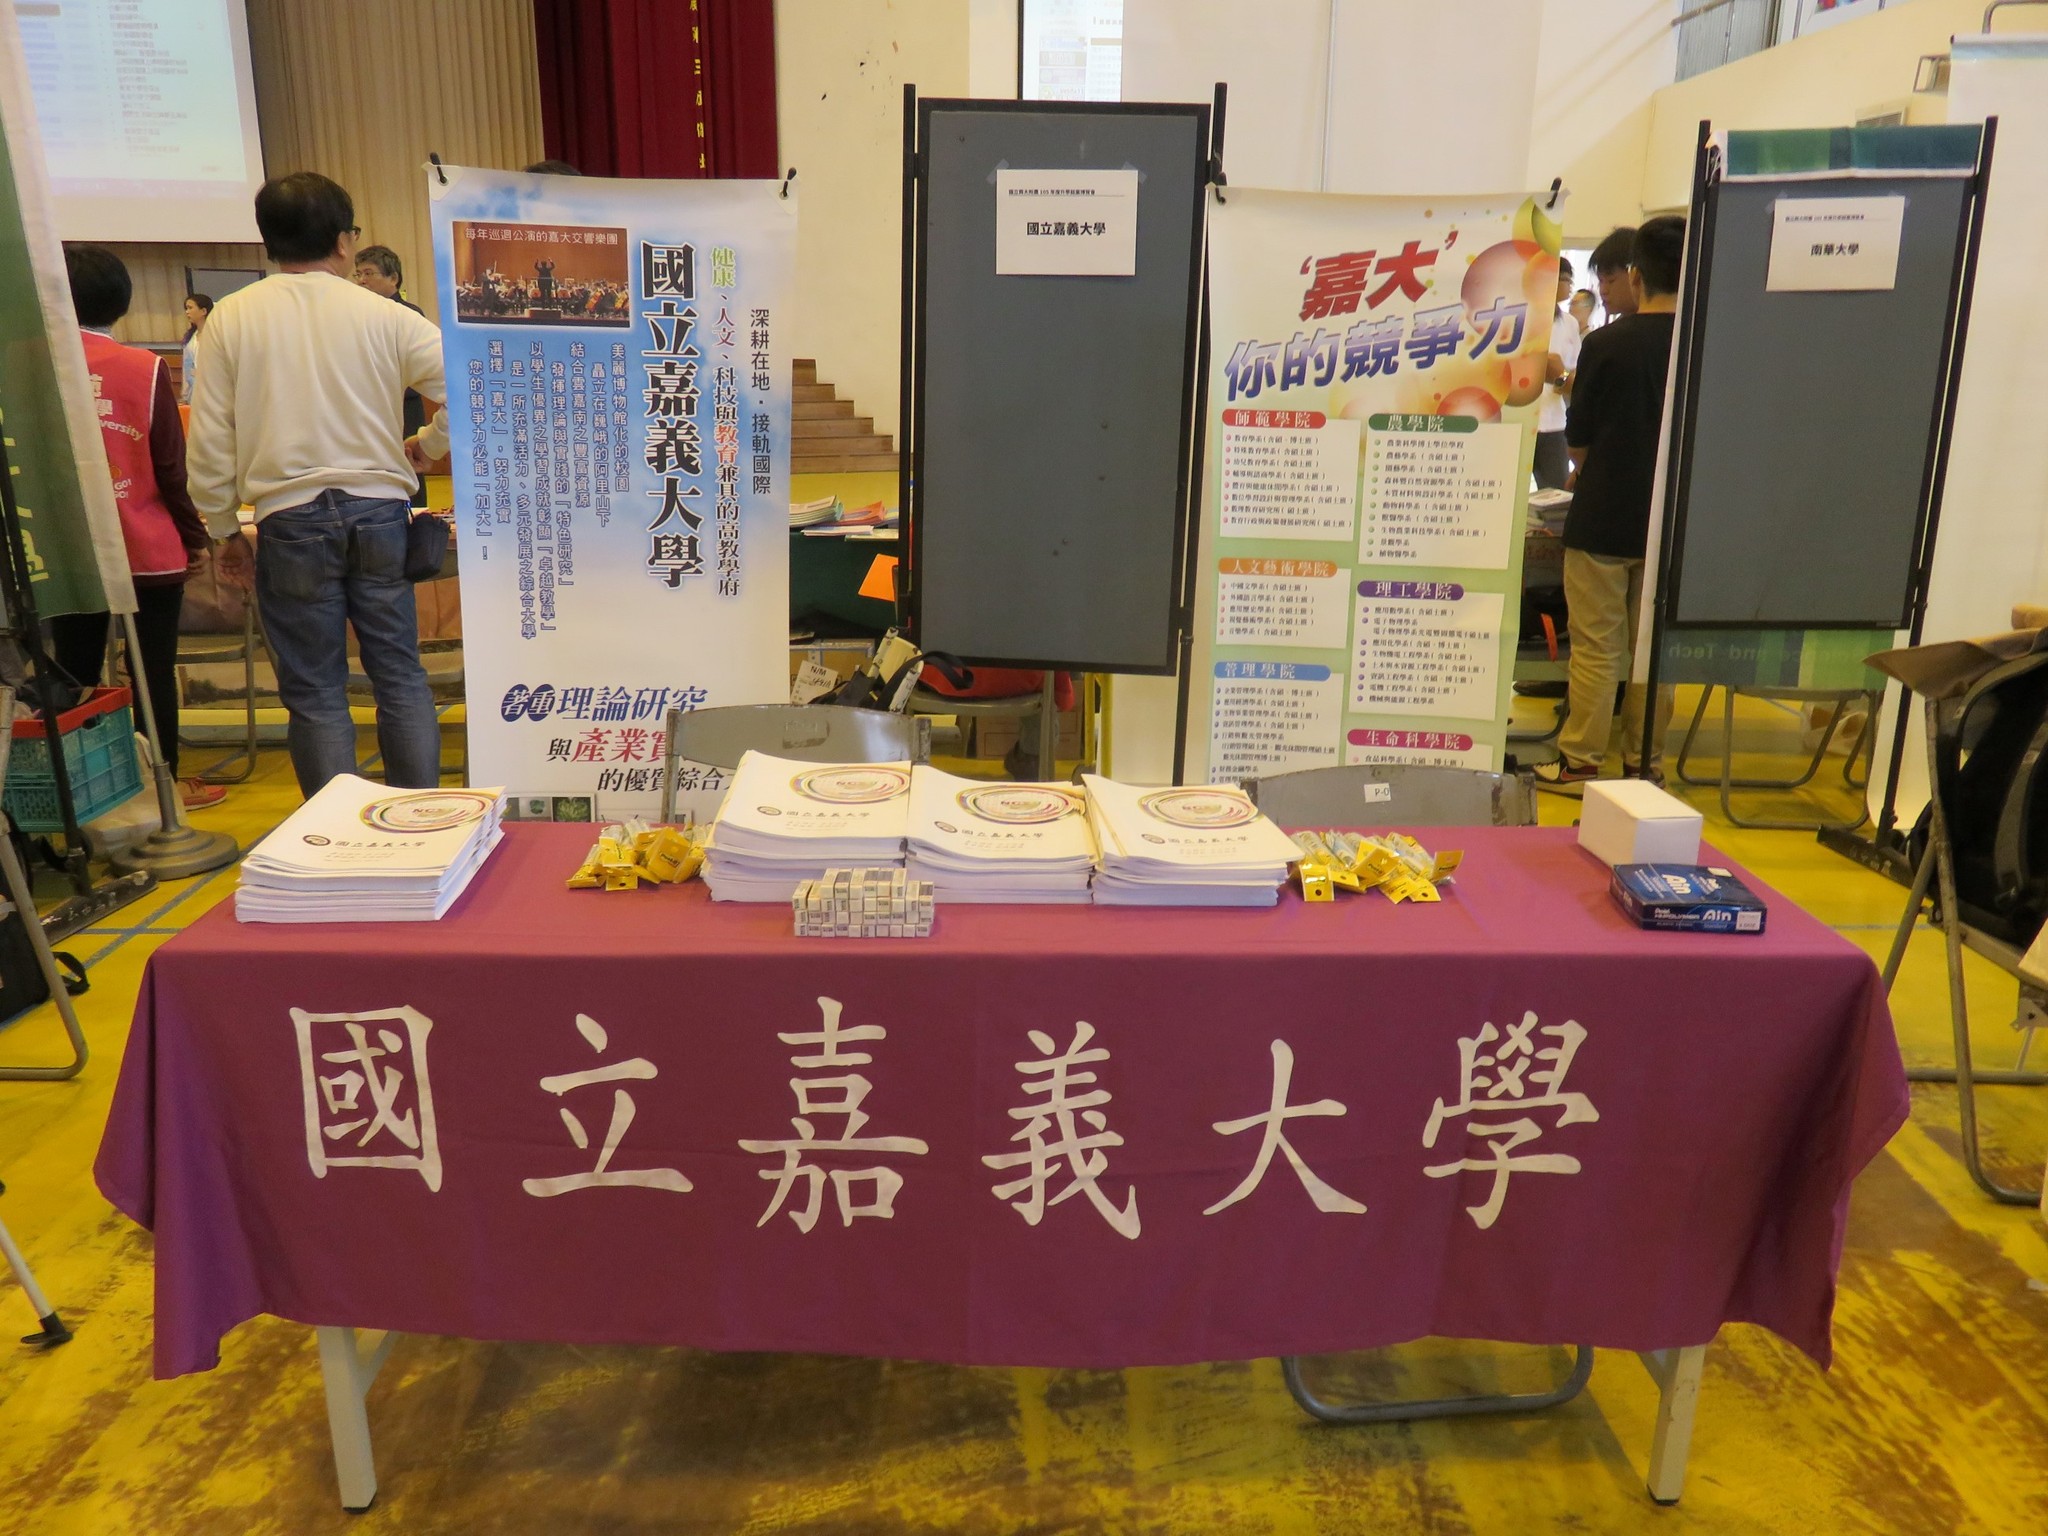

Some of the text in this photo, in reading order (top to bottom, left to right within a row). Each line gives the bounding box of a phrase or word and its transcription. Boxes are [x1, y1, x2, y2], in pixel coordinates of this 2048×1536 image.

[465, 227, 619, 246] 每年巡迴公演的嘉大交響樂團
[1027, 222, 1105, 235] 國立嘉義大學
[1811, 243, 1860, 256] 南華大學
[1224, 297, 1528, 402] 你的競爭力
[611, 343, 630, 492] 美麗博物館化的校園
[640, 240, 705, 589] 國立嘉義大學
[1235, 410, 1311, 428] 師範學院
[1387, 414, 1445, 432] 農學院
[570, 342, 590, 508] 結合雲嘉南之豐富資源
[1232, 559, 1329, 577] 人文藝術學院
[1375, 582, 1452, 600] 理工學院
[1224, 662, 1296, 679] 管理學院
[502, 685, 708, 721] 著重理論研究
[1366, 730, 1461, 750] 生命科學院
[598, 767, 735, 792] 的優質綜合
[1703, 909, 1732, 921] Ain
[290, 996, 1599, 1240] 國立嘉義大學
